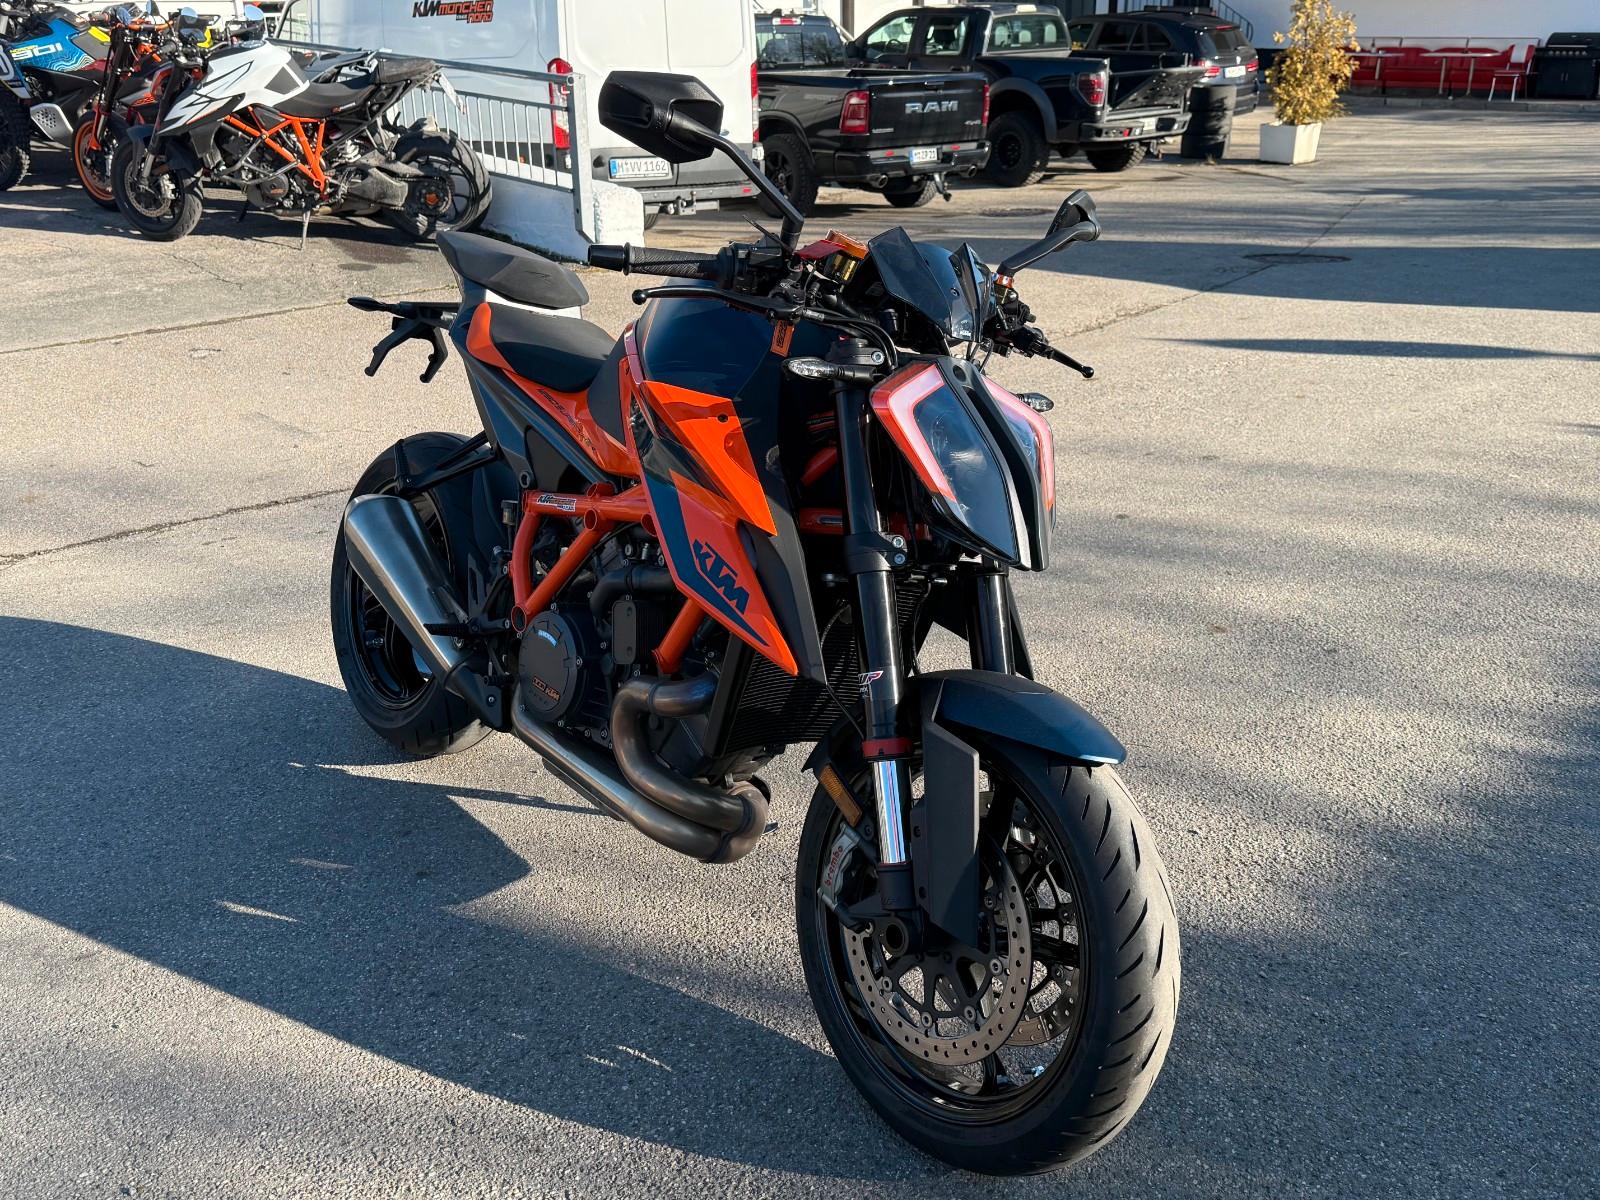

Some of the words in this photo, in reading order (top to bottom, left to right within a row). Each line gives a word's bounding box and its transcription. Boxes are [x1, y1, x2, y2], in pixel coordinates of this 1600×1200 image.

[11, 42, 63, 60] 901
[905, 100, 958, 114] RAM
[644, 160, 667, 172] 1162
[693, 538, 750, 615] KTM
[824, 845, 844, 887] brembo
